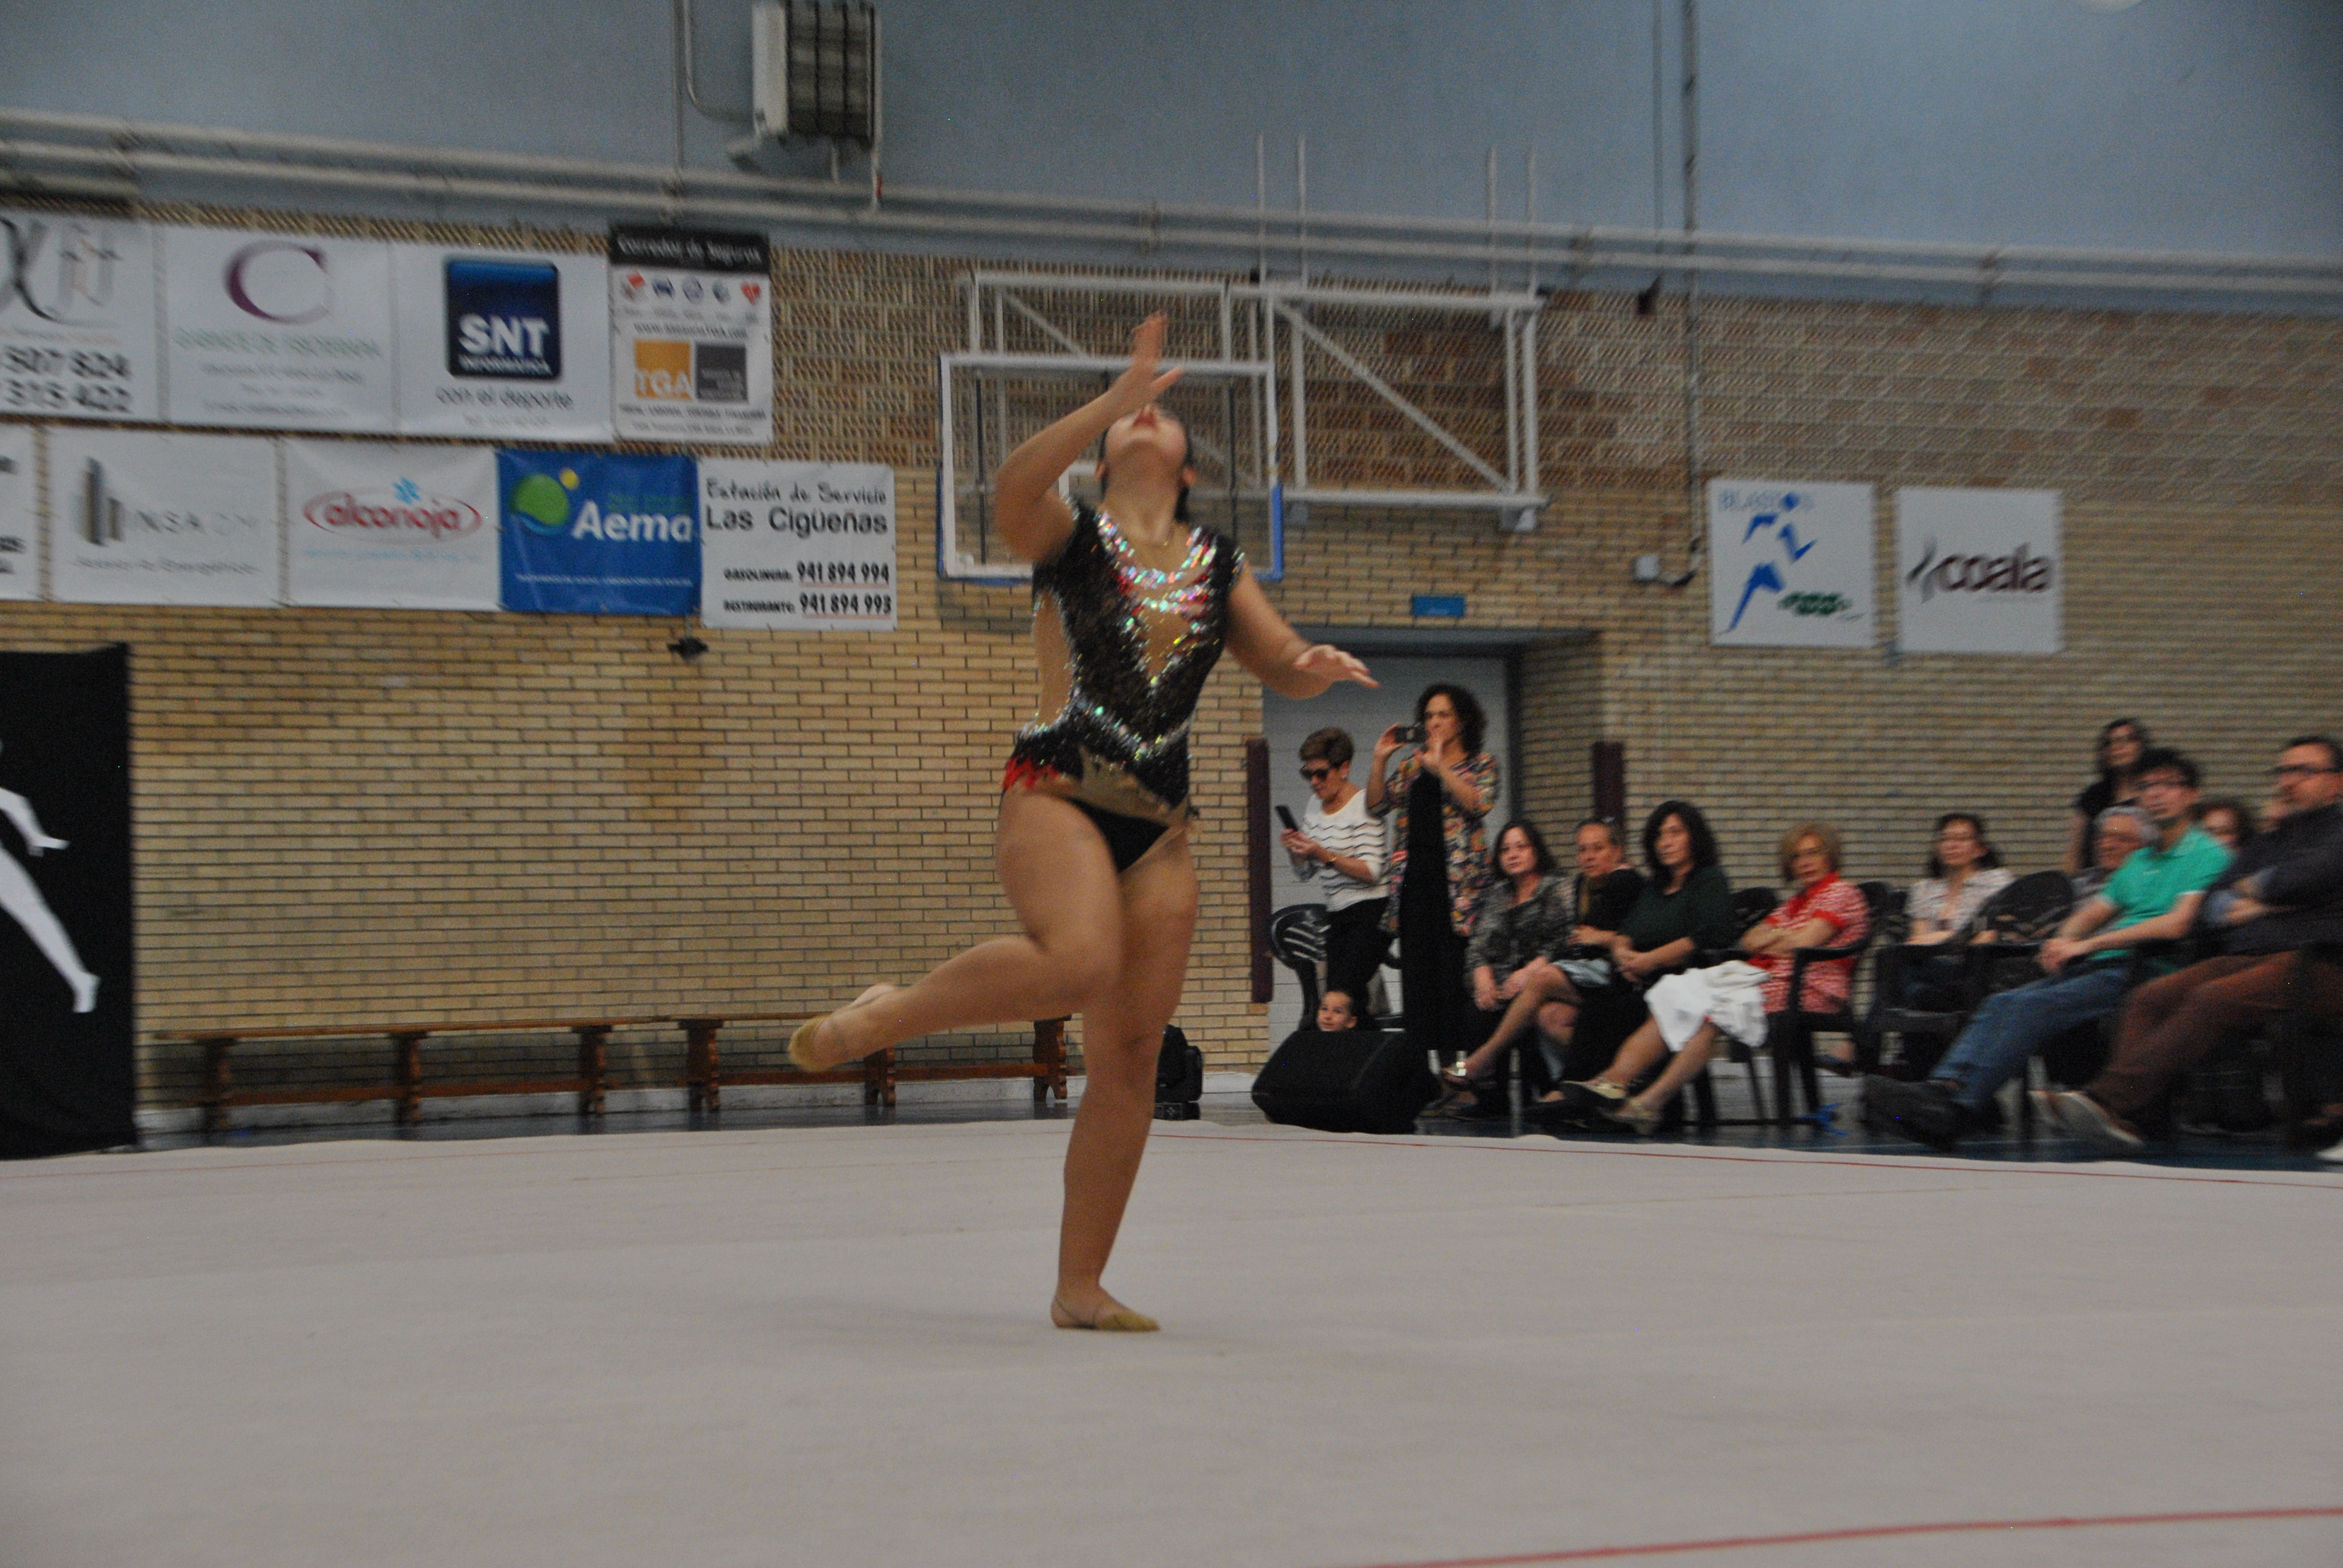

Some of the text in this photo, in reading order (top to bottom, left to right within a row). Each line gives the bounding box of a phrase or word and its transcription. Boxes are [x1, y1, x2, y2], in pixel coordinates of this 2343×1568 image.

[458, 313, 550, 356] SNT
[788, 482, 811, 503] de
[571, 500, 694, 543] Aema
[706, 505, 753, 532] Las
[796, 560, 824, 584] 941
[827, 561, 855, 585] 894
[860, 563, 890, 586] 994
[798, 592, 827, 615] 941
[829, 593, 860, 616] 894
[863, 593, 893, 616] 993
